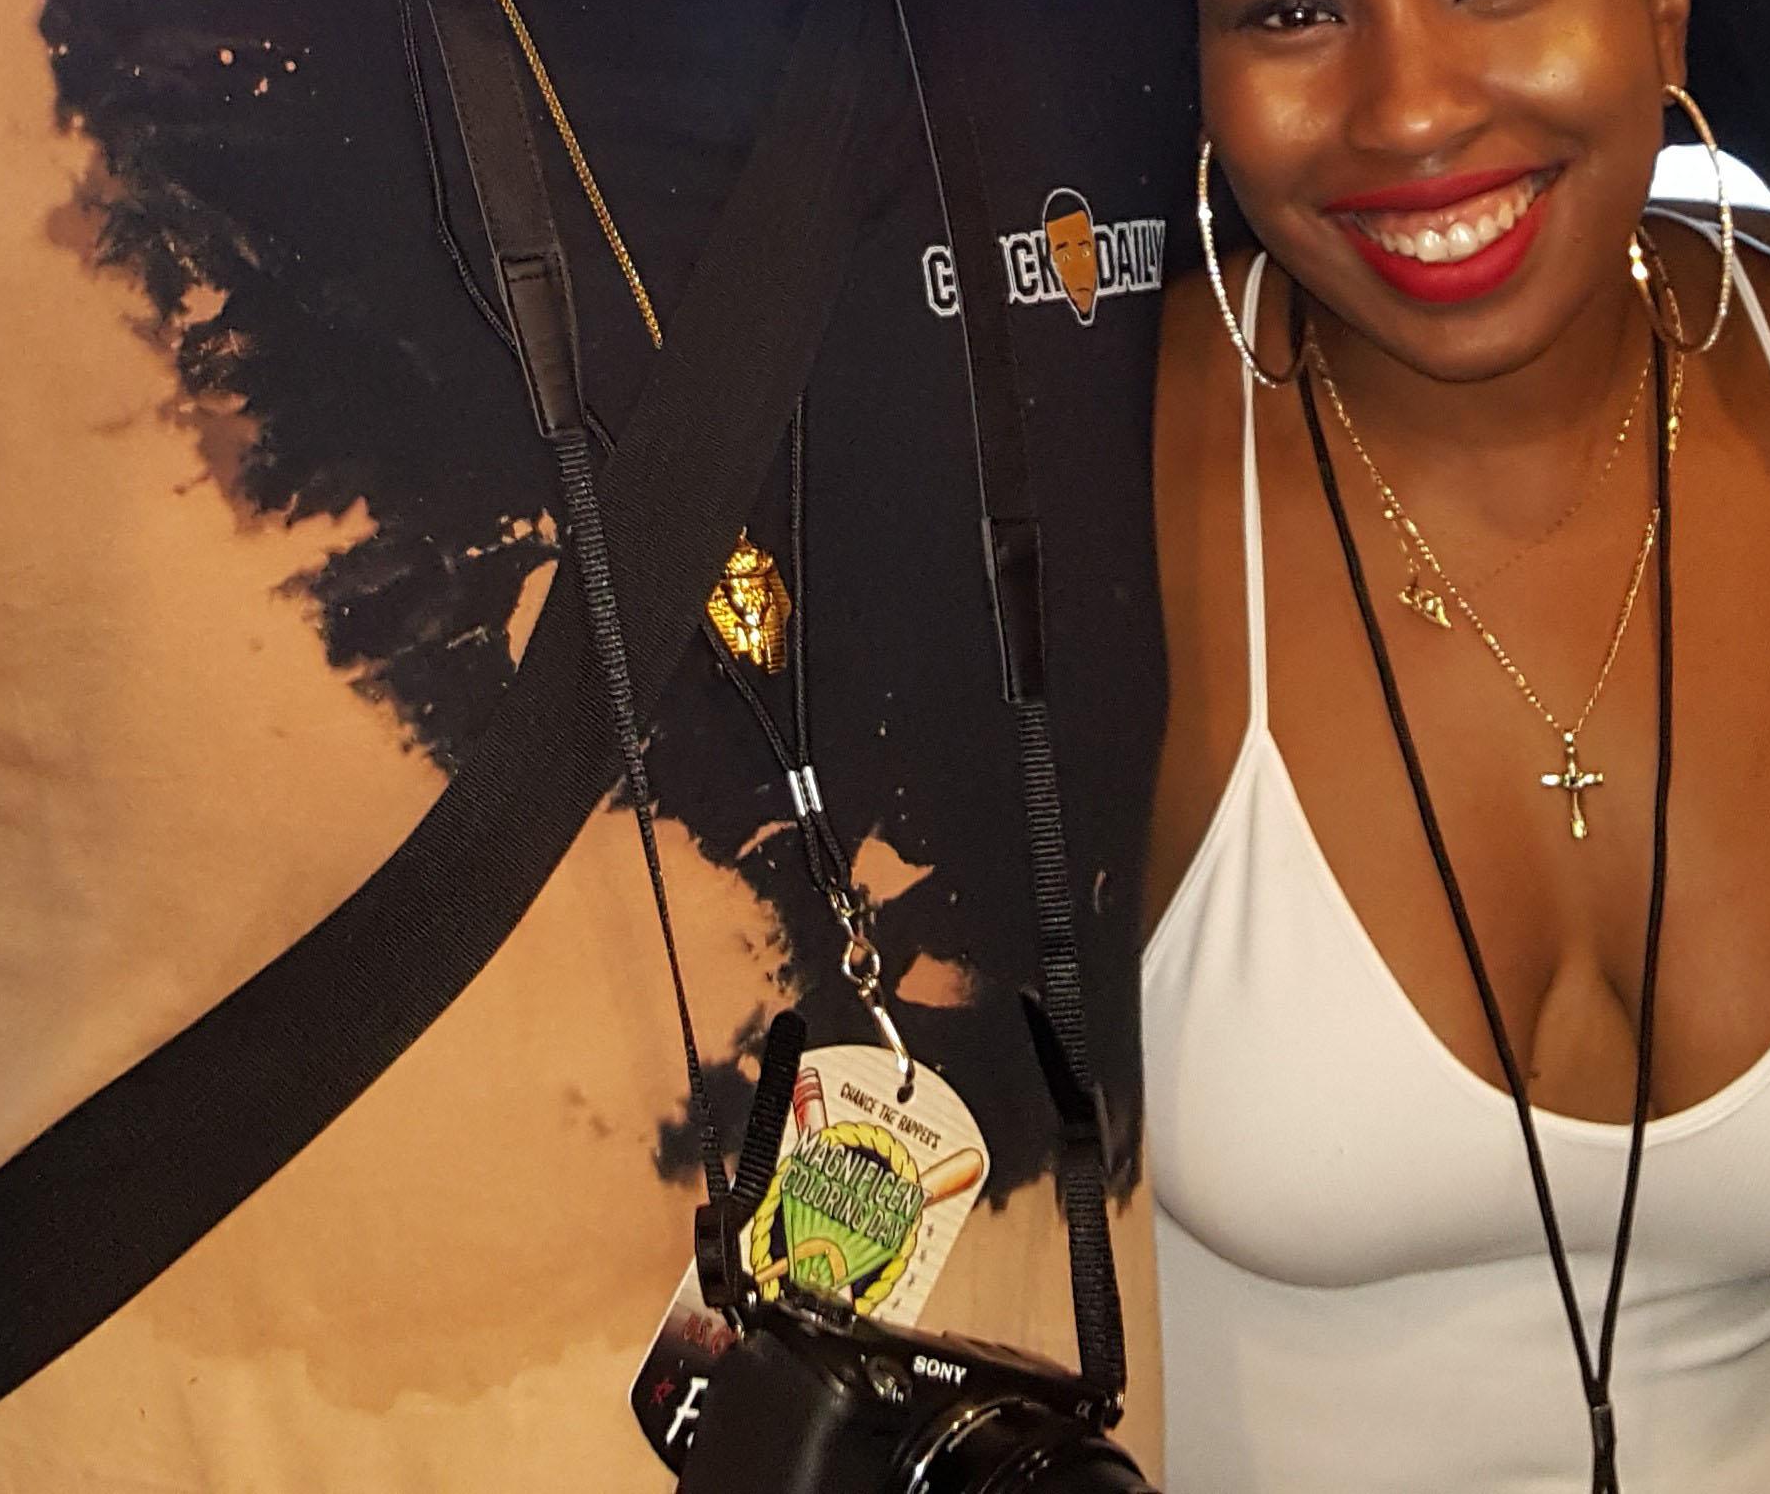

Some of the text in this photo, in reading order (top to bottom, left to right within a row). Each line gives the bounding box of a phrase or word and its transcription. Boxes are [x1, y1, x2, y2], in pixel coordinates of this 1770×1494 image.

[839, 1082, 878, 1115] CHANCE
[879, 1103, 900, 1126] THE
[792, 1125, 932, 1221] MAGNIFICENT
[782, 1165, 907, 1249] COLORING DAY
[912, 1355, 968, 1386] SONY
